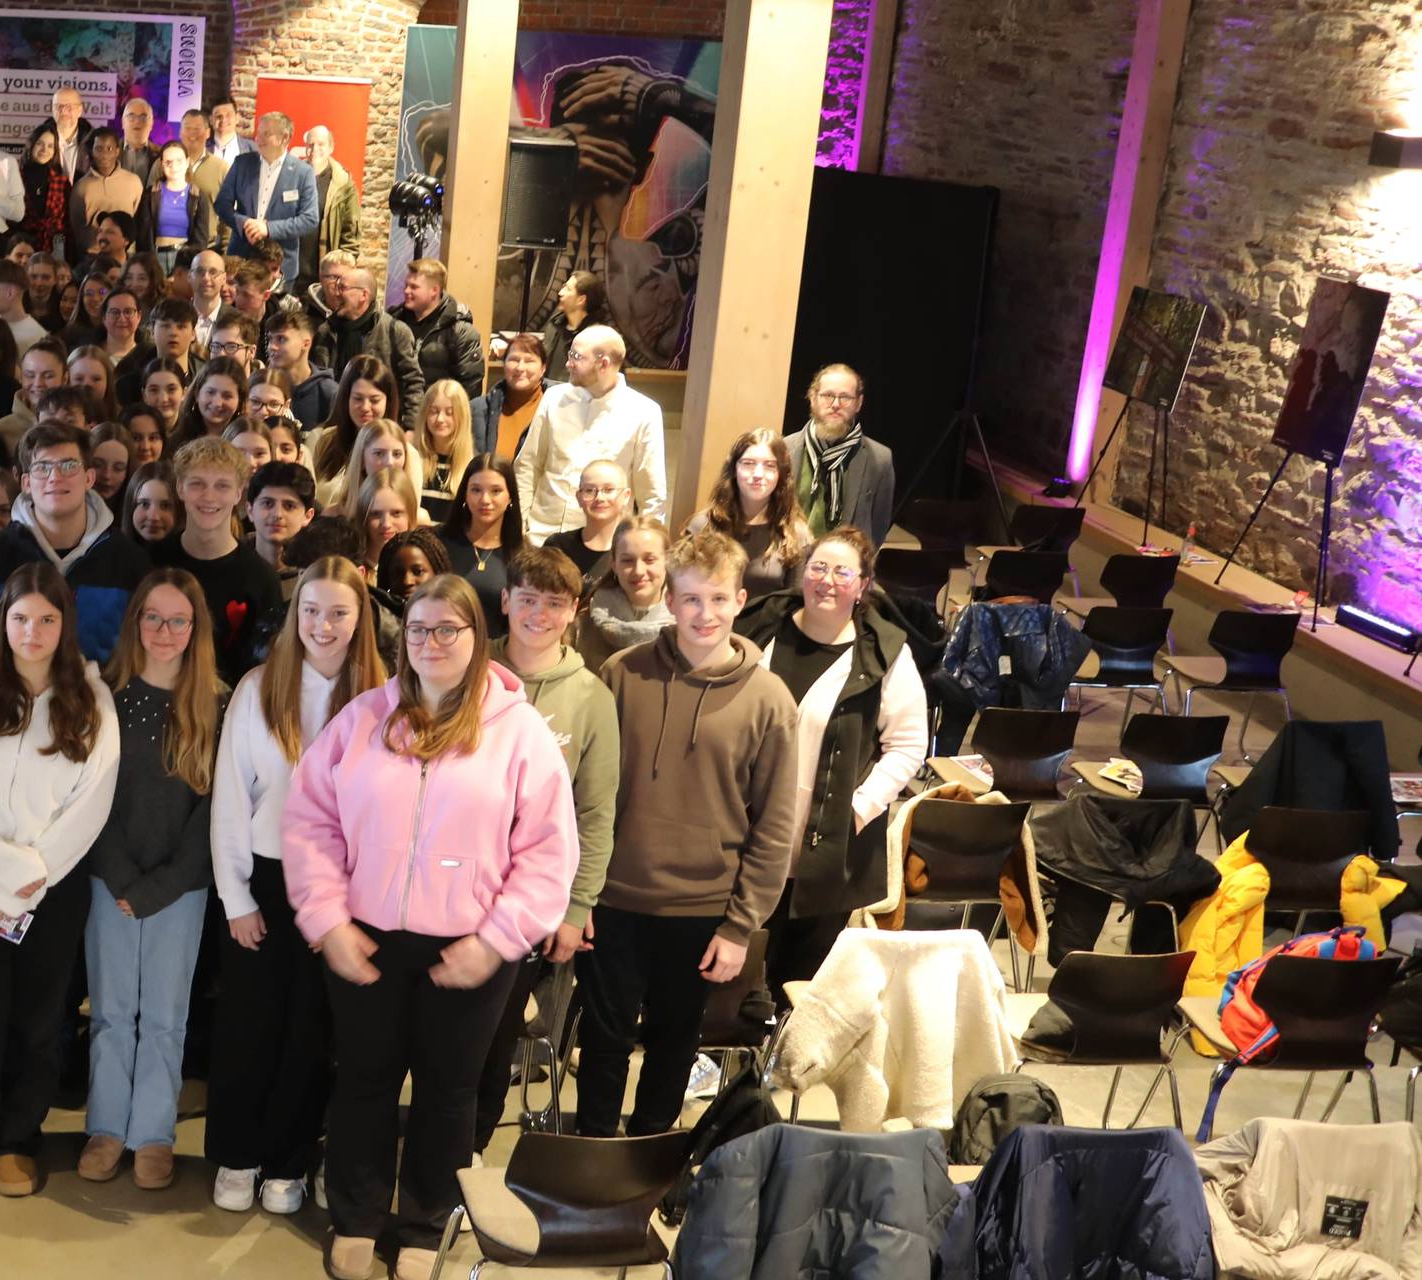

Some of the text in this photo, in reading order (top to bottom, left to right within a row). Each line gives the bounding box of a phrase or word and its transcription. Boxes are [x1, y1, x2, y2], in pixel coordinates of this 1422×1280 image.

[178, 23, 198, 98] VISIONS
[2, 76, 43, 93] your
[47, 76, 113, 93] visions.
[12, 101, 40, 113] aus
